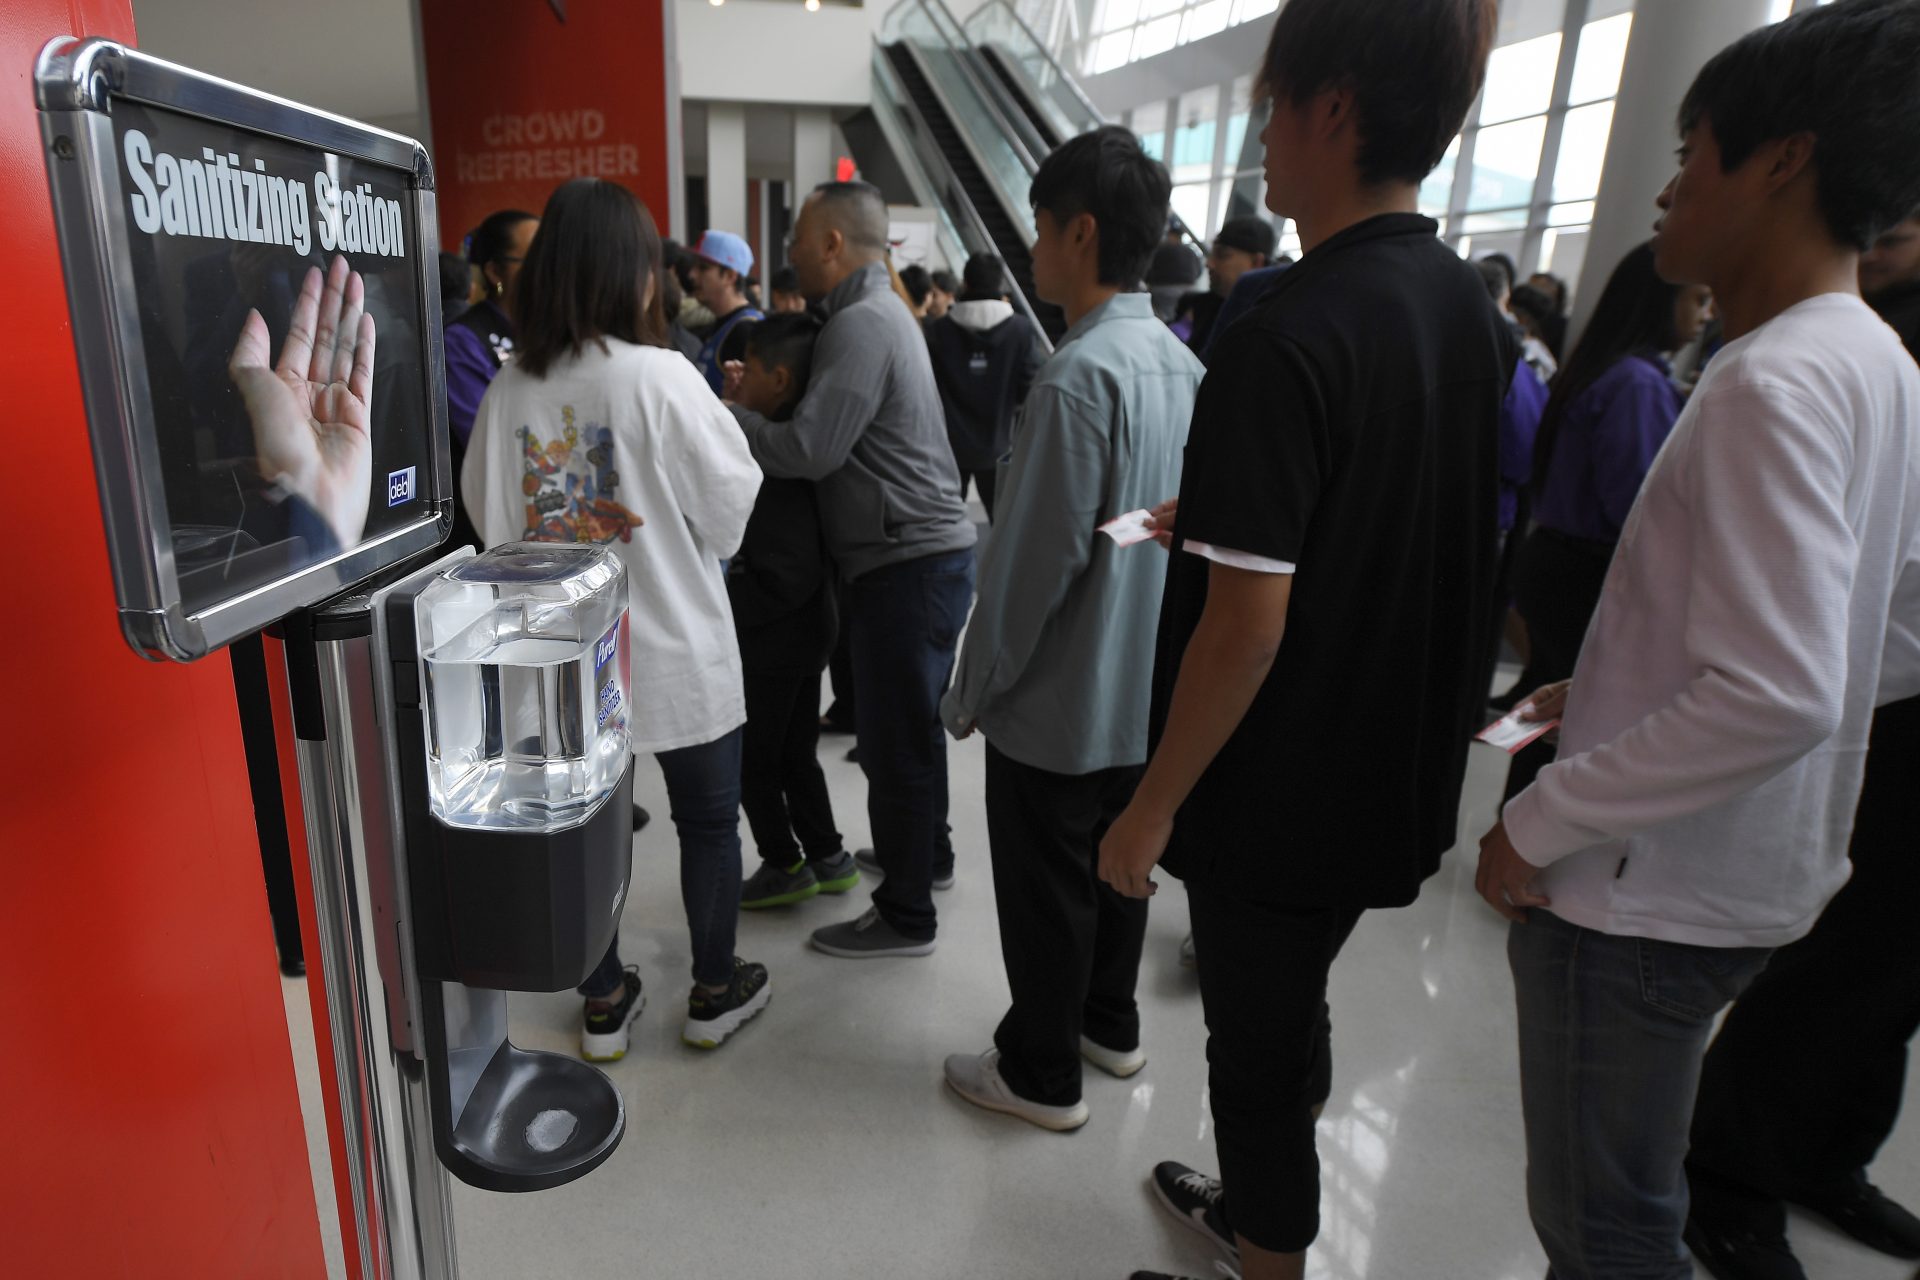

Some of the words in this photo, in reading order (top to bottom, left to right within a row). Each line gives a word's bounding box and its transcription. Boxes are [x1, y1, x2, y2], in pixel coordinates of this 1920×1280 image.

[482, 109, 605, 146] CROWD
[456, 144, 640, 183] REFRESHER
[124, 129, 311, 256] Sanitizing
[314, 171, 405, 257] Station
[390, 475, 408, 499] deb
[599, 690, 621, 726] SANITIZER
[600, 680, 615, 702] HAND
